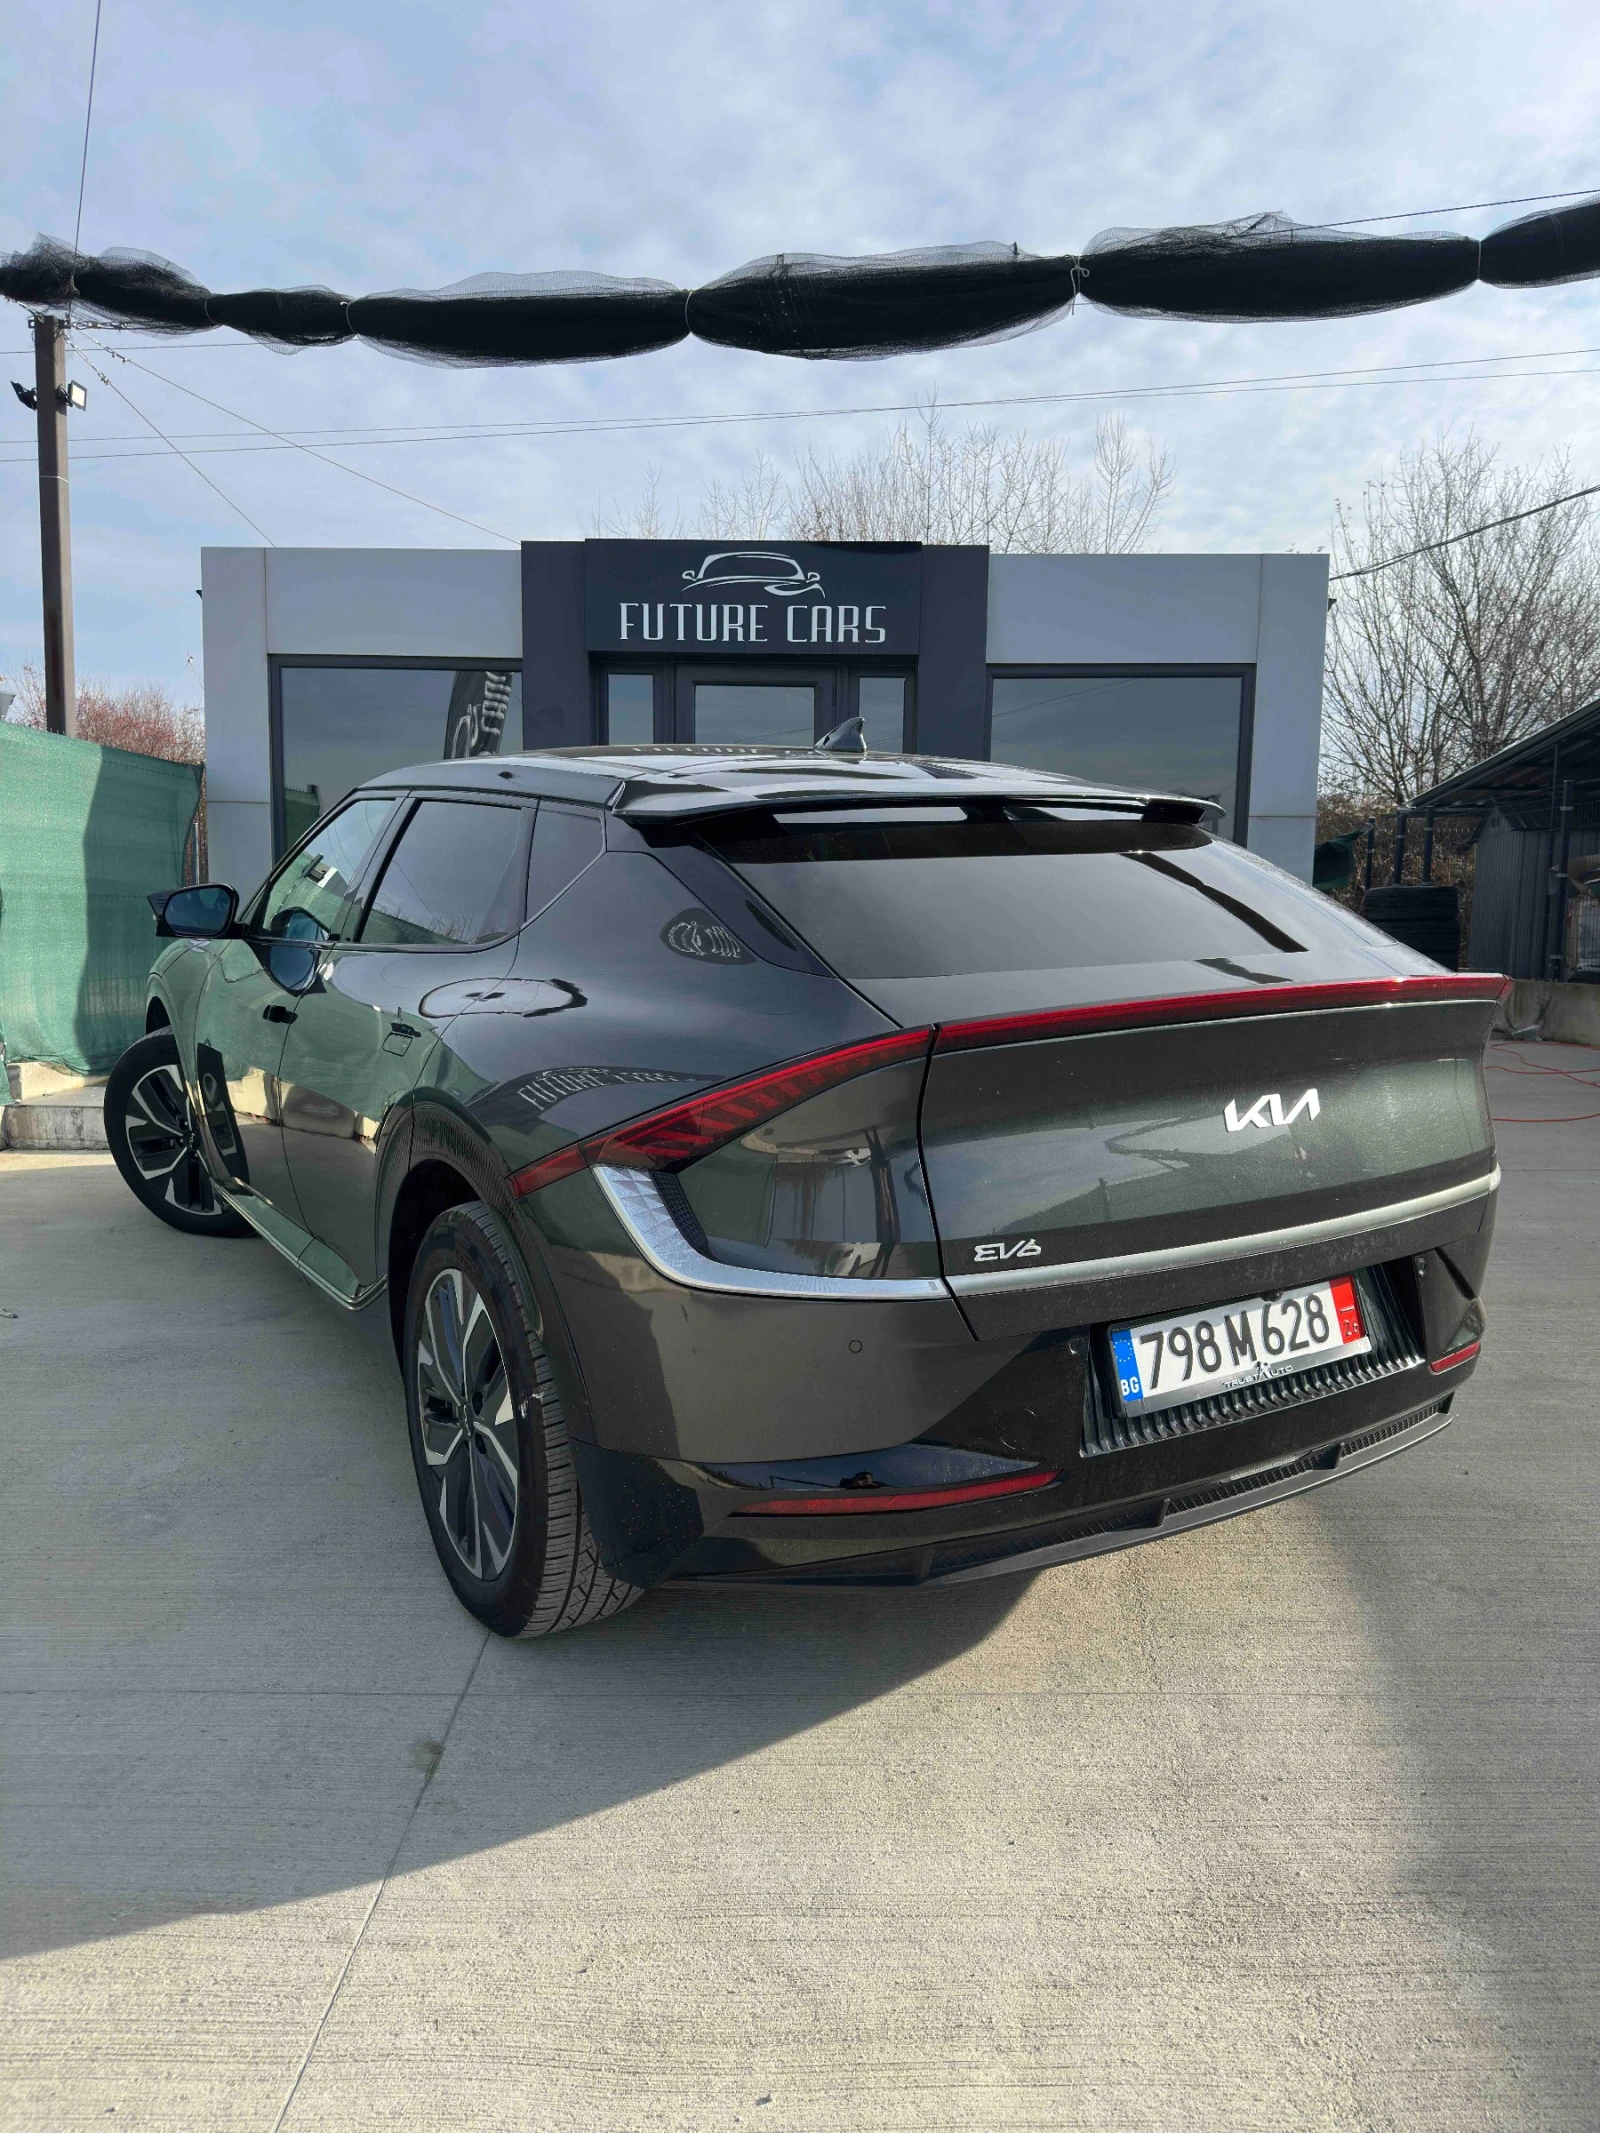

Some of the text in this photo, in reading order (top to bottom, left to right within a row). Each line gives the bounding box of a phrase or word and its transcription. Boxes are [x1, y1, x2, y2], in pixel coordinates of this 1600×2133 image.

[619, 603, 887, 643] FUTURE CARS
[1223, 1088, 1320, 1132] KIA
[974, 1239, 1042, 1262] EV6
[1120, 1376, 1140, 1396] BG
